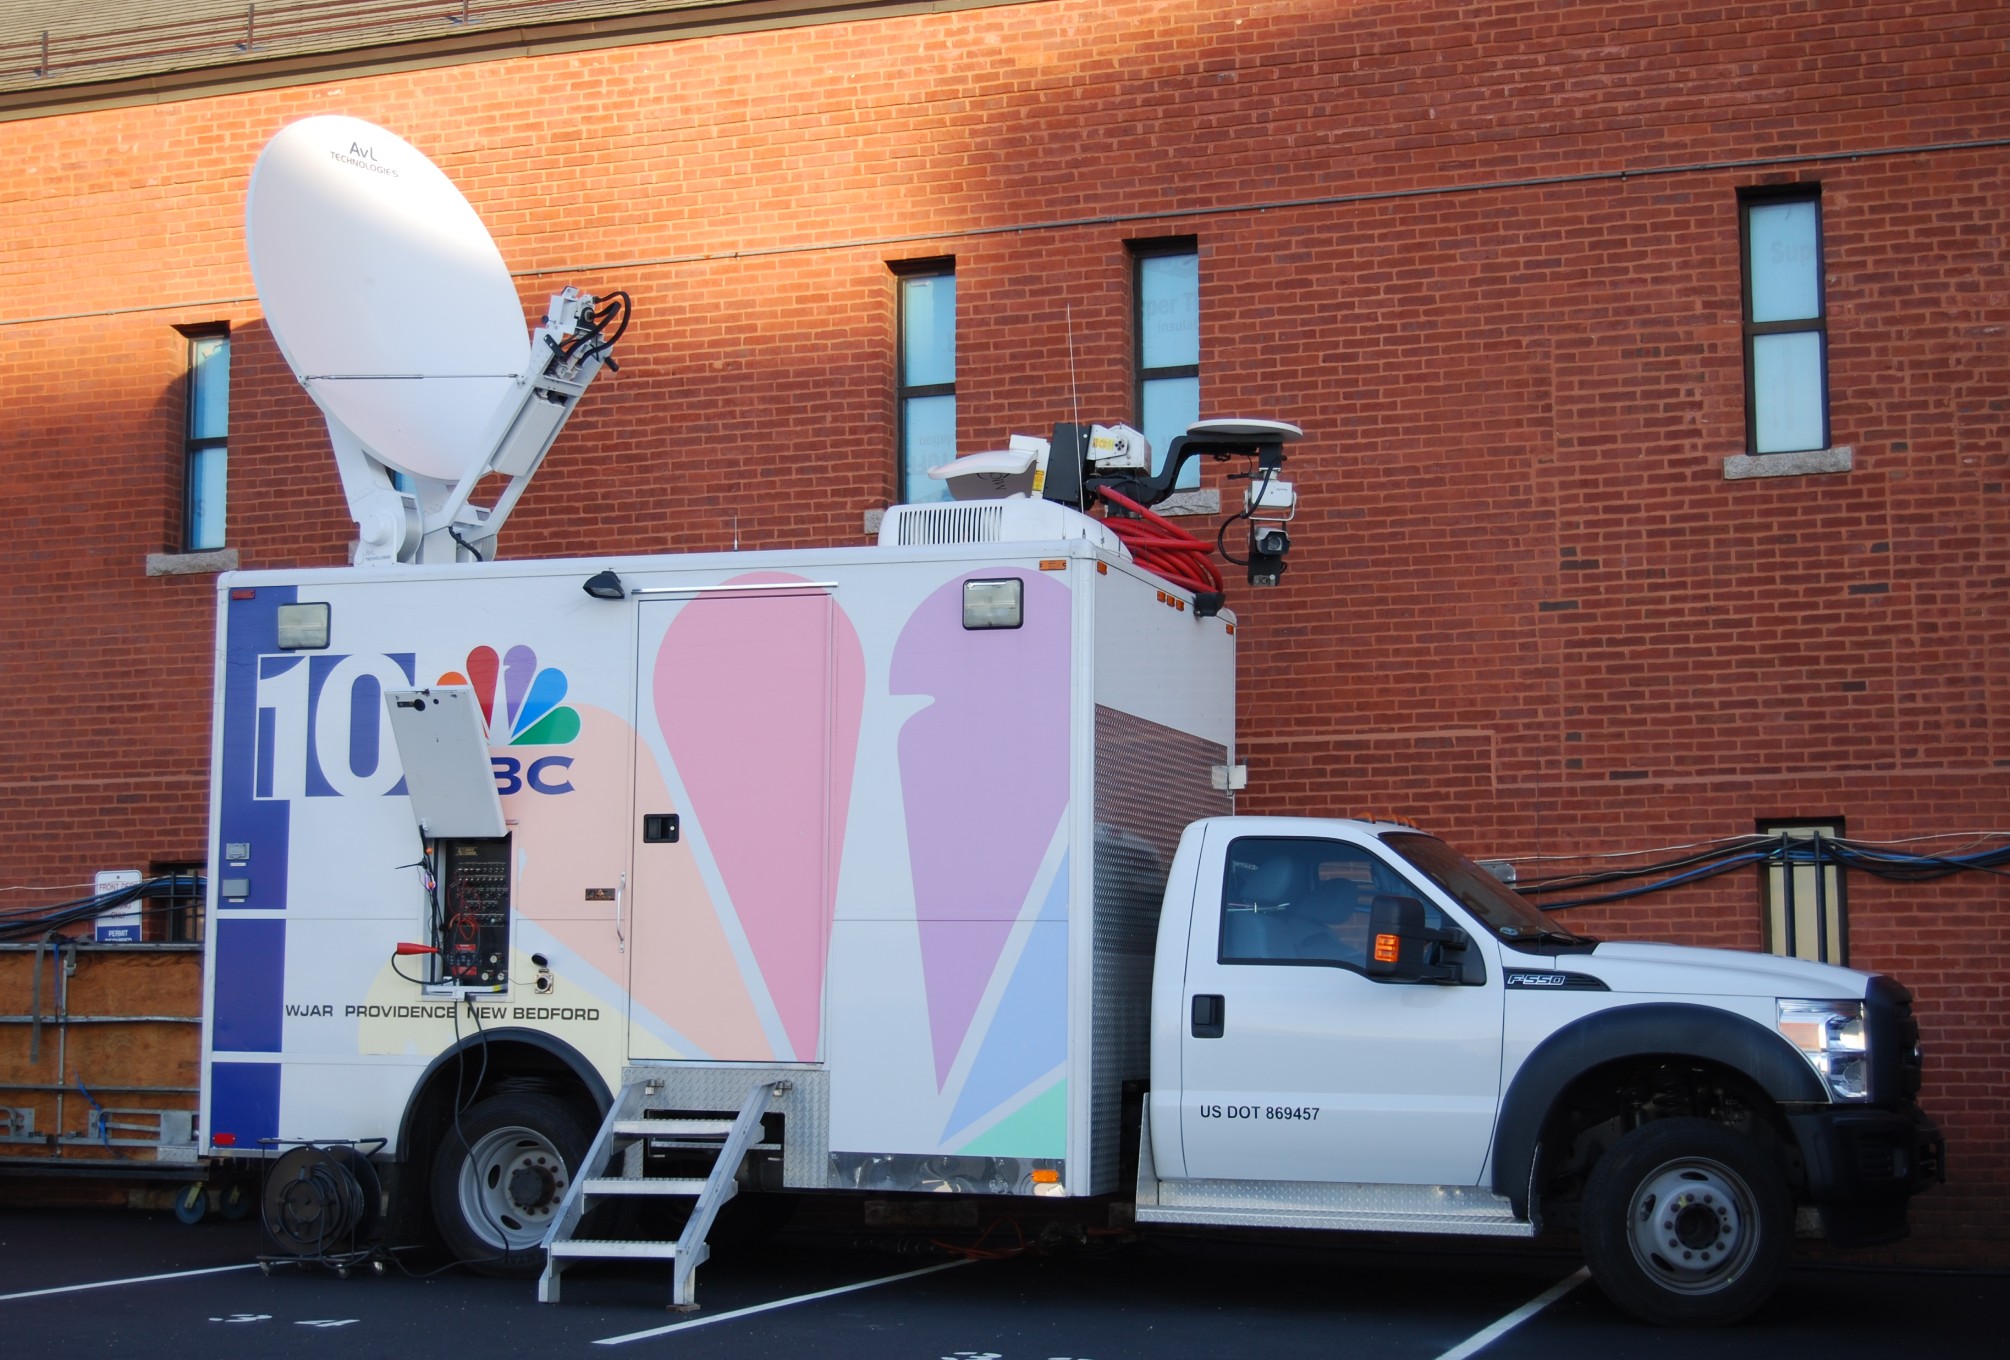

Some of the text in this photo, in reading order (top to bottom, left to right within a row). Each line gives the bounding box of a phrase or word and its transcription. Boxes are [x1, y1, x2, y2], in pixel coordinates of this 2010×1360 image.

[329, 150, 399, 177] TECHNOLOGIES
[254, 653, 414, 800] 10
[489, 755, 576, 796] BC
[108, 929, 129, 937] PERMIT
[285, 1004, 600, 1021] WJAR PROVIDENCE NEW BEDFORD
[1200, 1105, 1320, 1120] US DOT 869457
